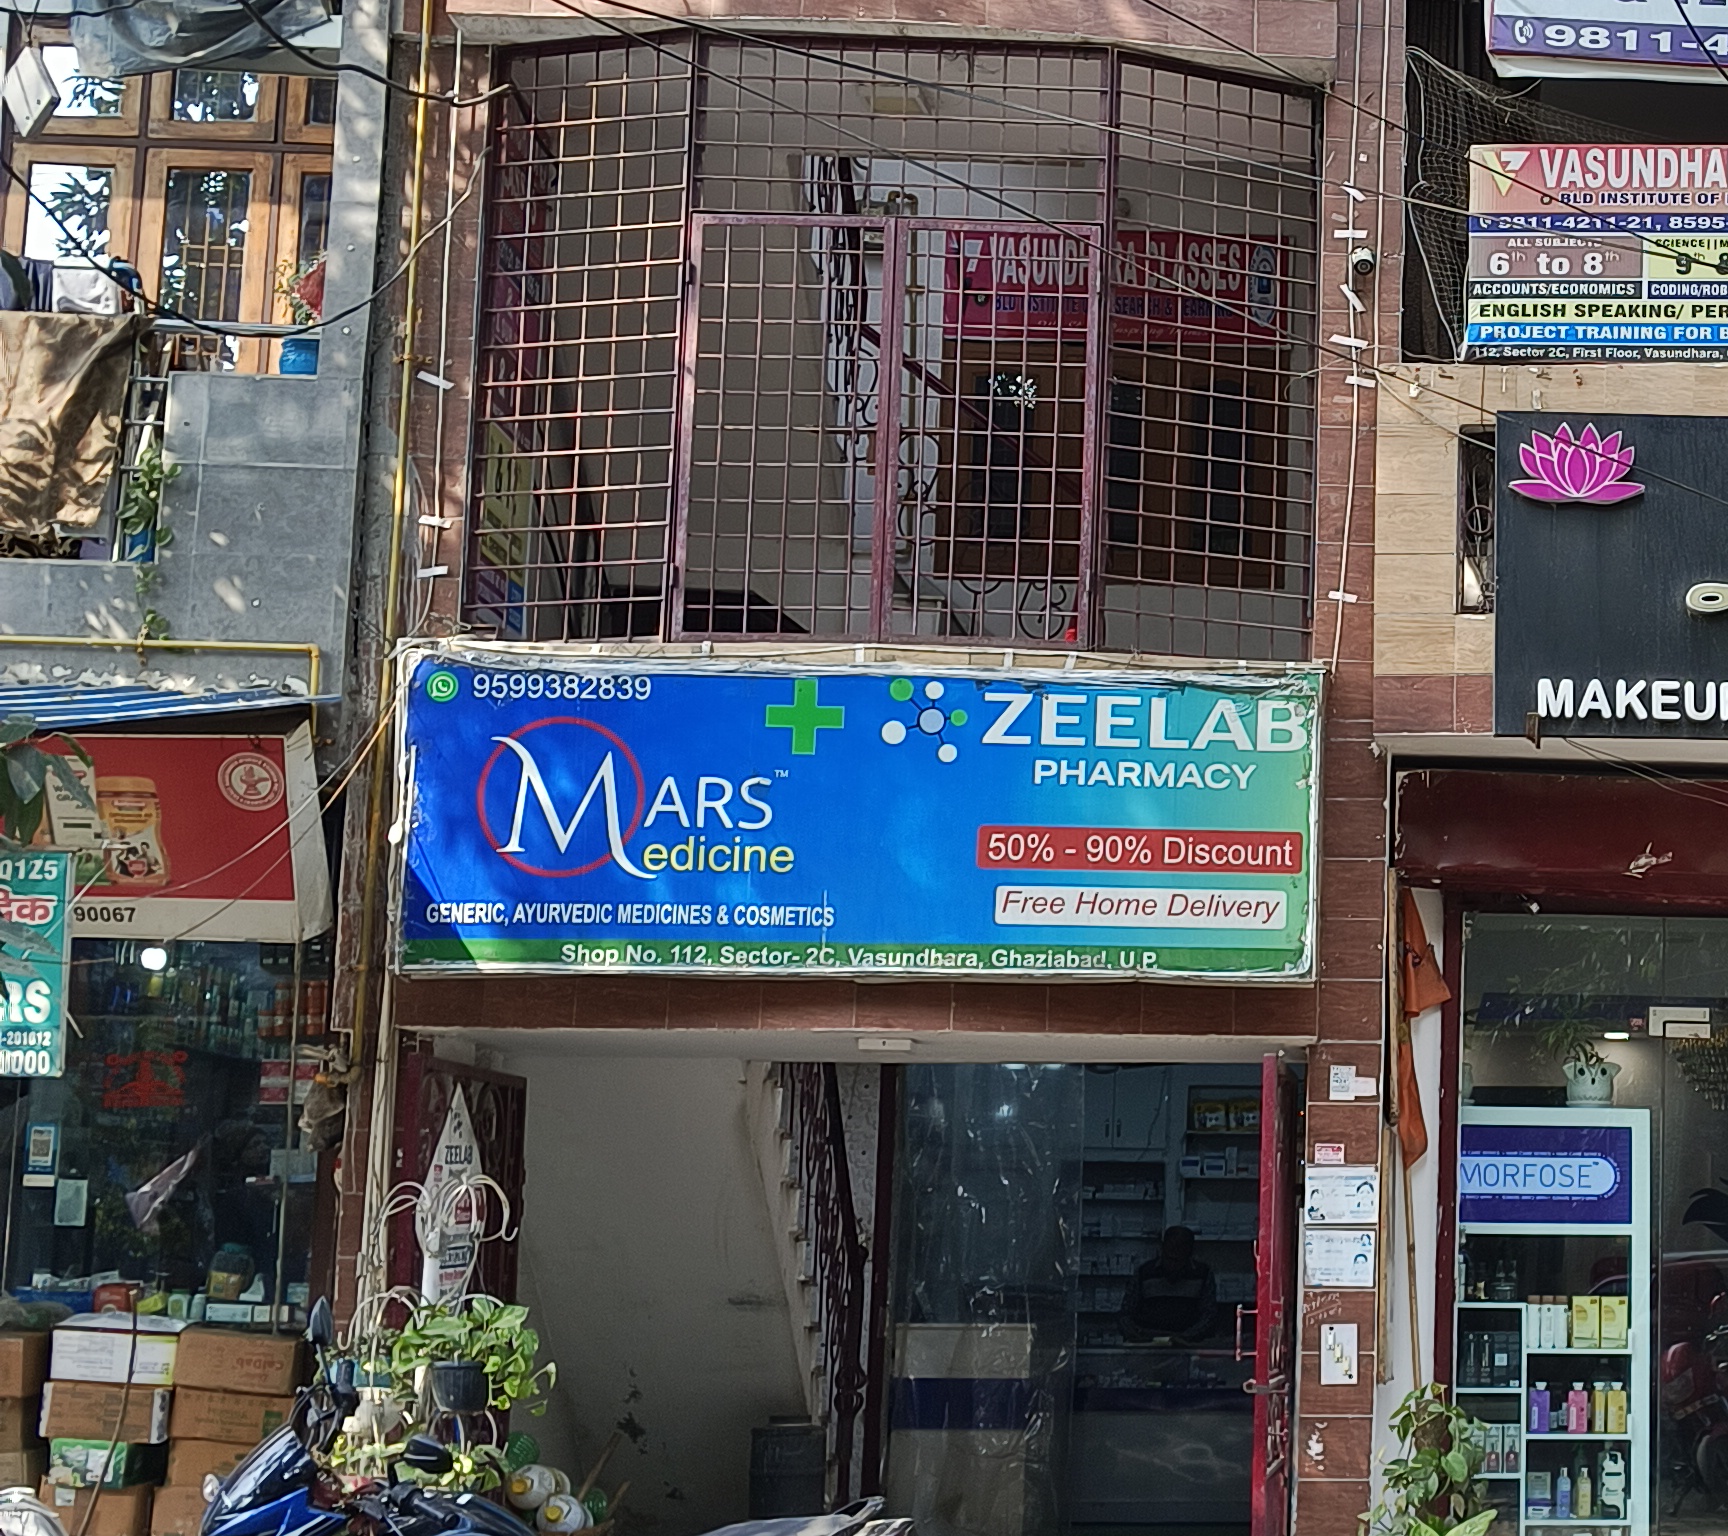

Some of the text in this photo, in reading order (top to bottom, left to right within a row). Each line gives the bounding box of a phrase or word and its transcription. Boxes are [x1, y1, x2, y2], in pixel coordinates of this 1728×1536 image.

[1559, 193, 1593, 205] BLD
[1600, 193, 1690, 205] INSTITUTE
[1697, 193, 1721, 205] OF
[1537, 252, 1570, 276] to
[1472, 282, 1636, 296] ACCOUNTS/ECONOMICS
[1479, 304, 1567, 319] ENGLISH
[1574, 304, 1685, 320] SPEAKING/
[1480, 325, 1569, 340] PROJECT
[1575, 326, 1667, 340] TRAINING
[1674, 326, 1712, 340] FOR
[1503, 346, 1546, 357] Sector
[473, 673, 652, 701] 9599382839
[981, 691, 1308, 753] ZEELAB
[1033, 759, 1257, 790] PHARMACY
[987, 833, 1293, 867] 50% 90% Discount
[426, 903, 835, 927] GENERIC, AYURVEDIC MEDICINES & COSMETICS
[1001, 890, 1281, 925] Free Home Delivery
[560, 944, 618, 967] Shop
[626, 944, 662, 964] No.
[669, 946, 713, 967] 112,
[848, 947, 984, 971] Vasundhara,
[1461, 1162, 1593, 1188] MORFOSE
